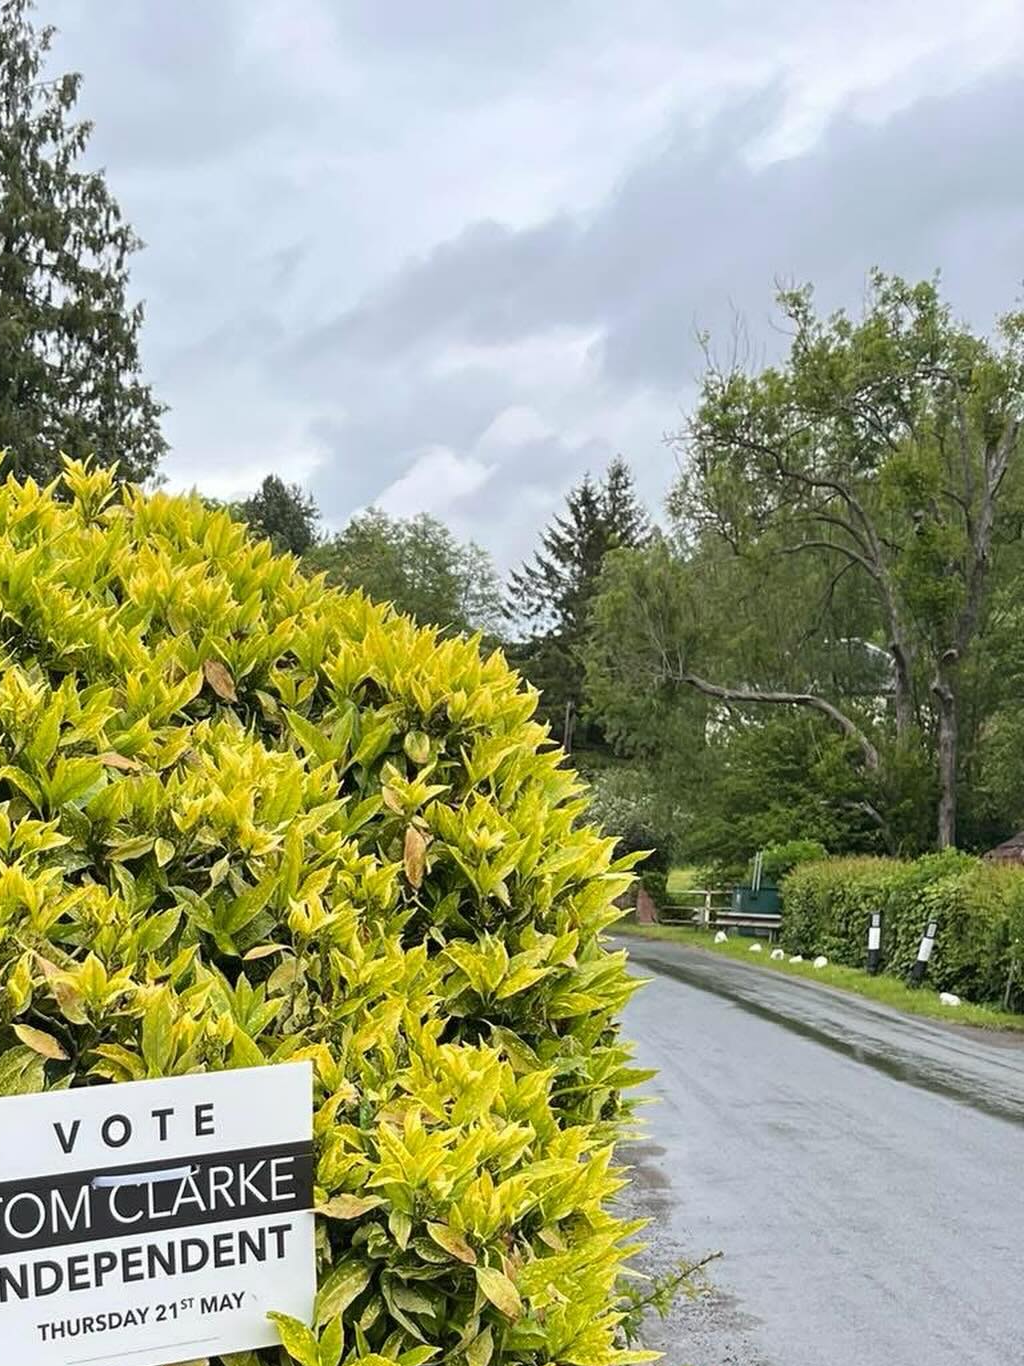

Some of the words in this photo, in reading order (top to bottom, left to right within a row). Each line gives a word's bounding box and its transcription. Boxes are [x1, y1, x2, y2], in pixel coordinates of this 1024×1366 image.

[53, 1103, 215, 1154] VOTE
[108, 1156, 297, 1225] CLARKE
[37, 1307, 150, 1341] THURSDAY
[155, 1298, 195, 1323] 21ST
[200, 1291, 246, 1315] MAY
